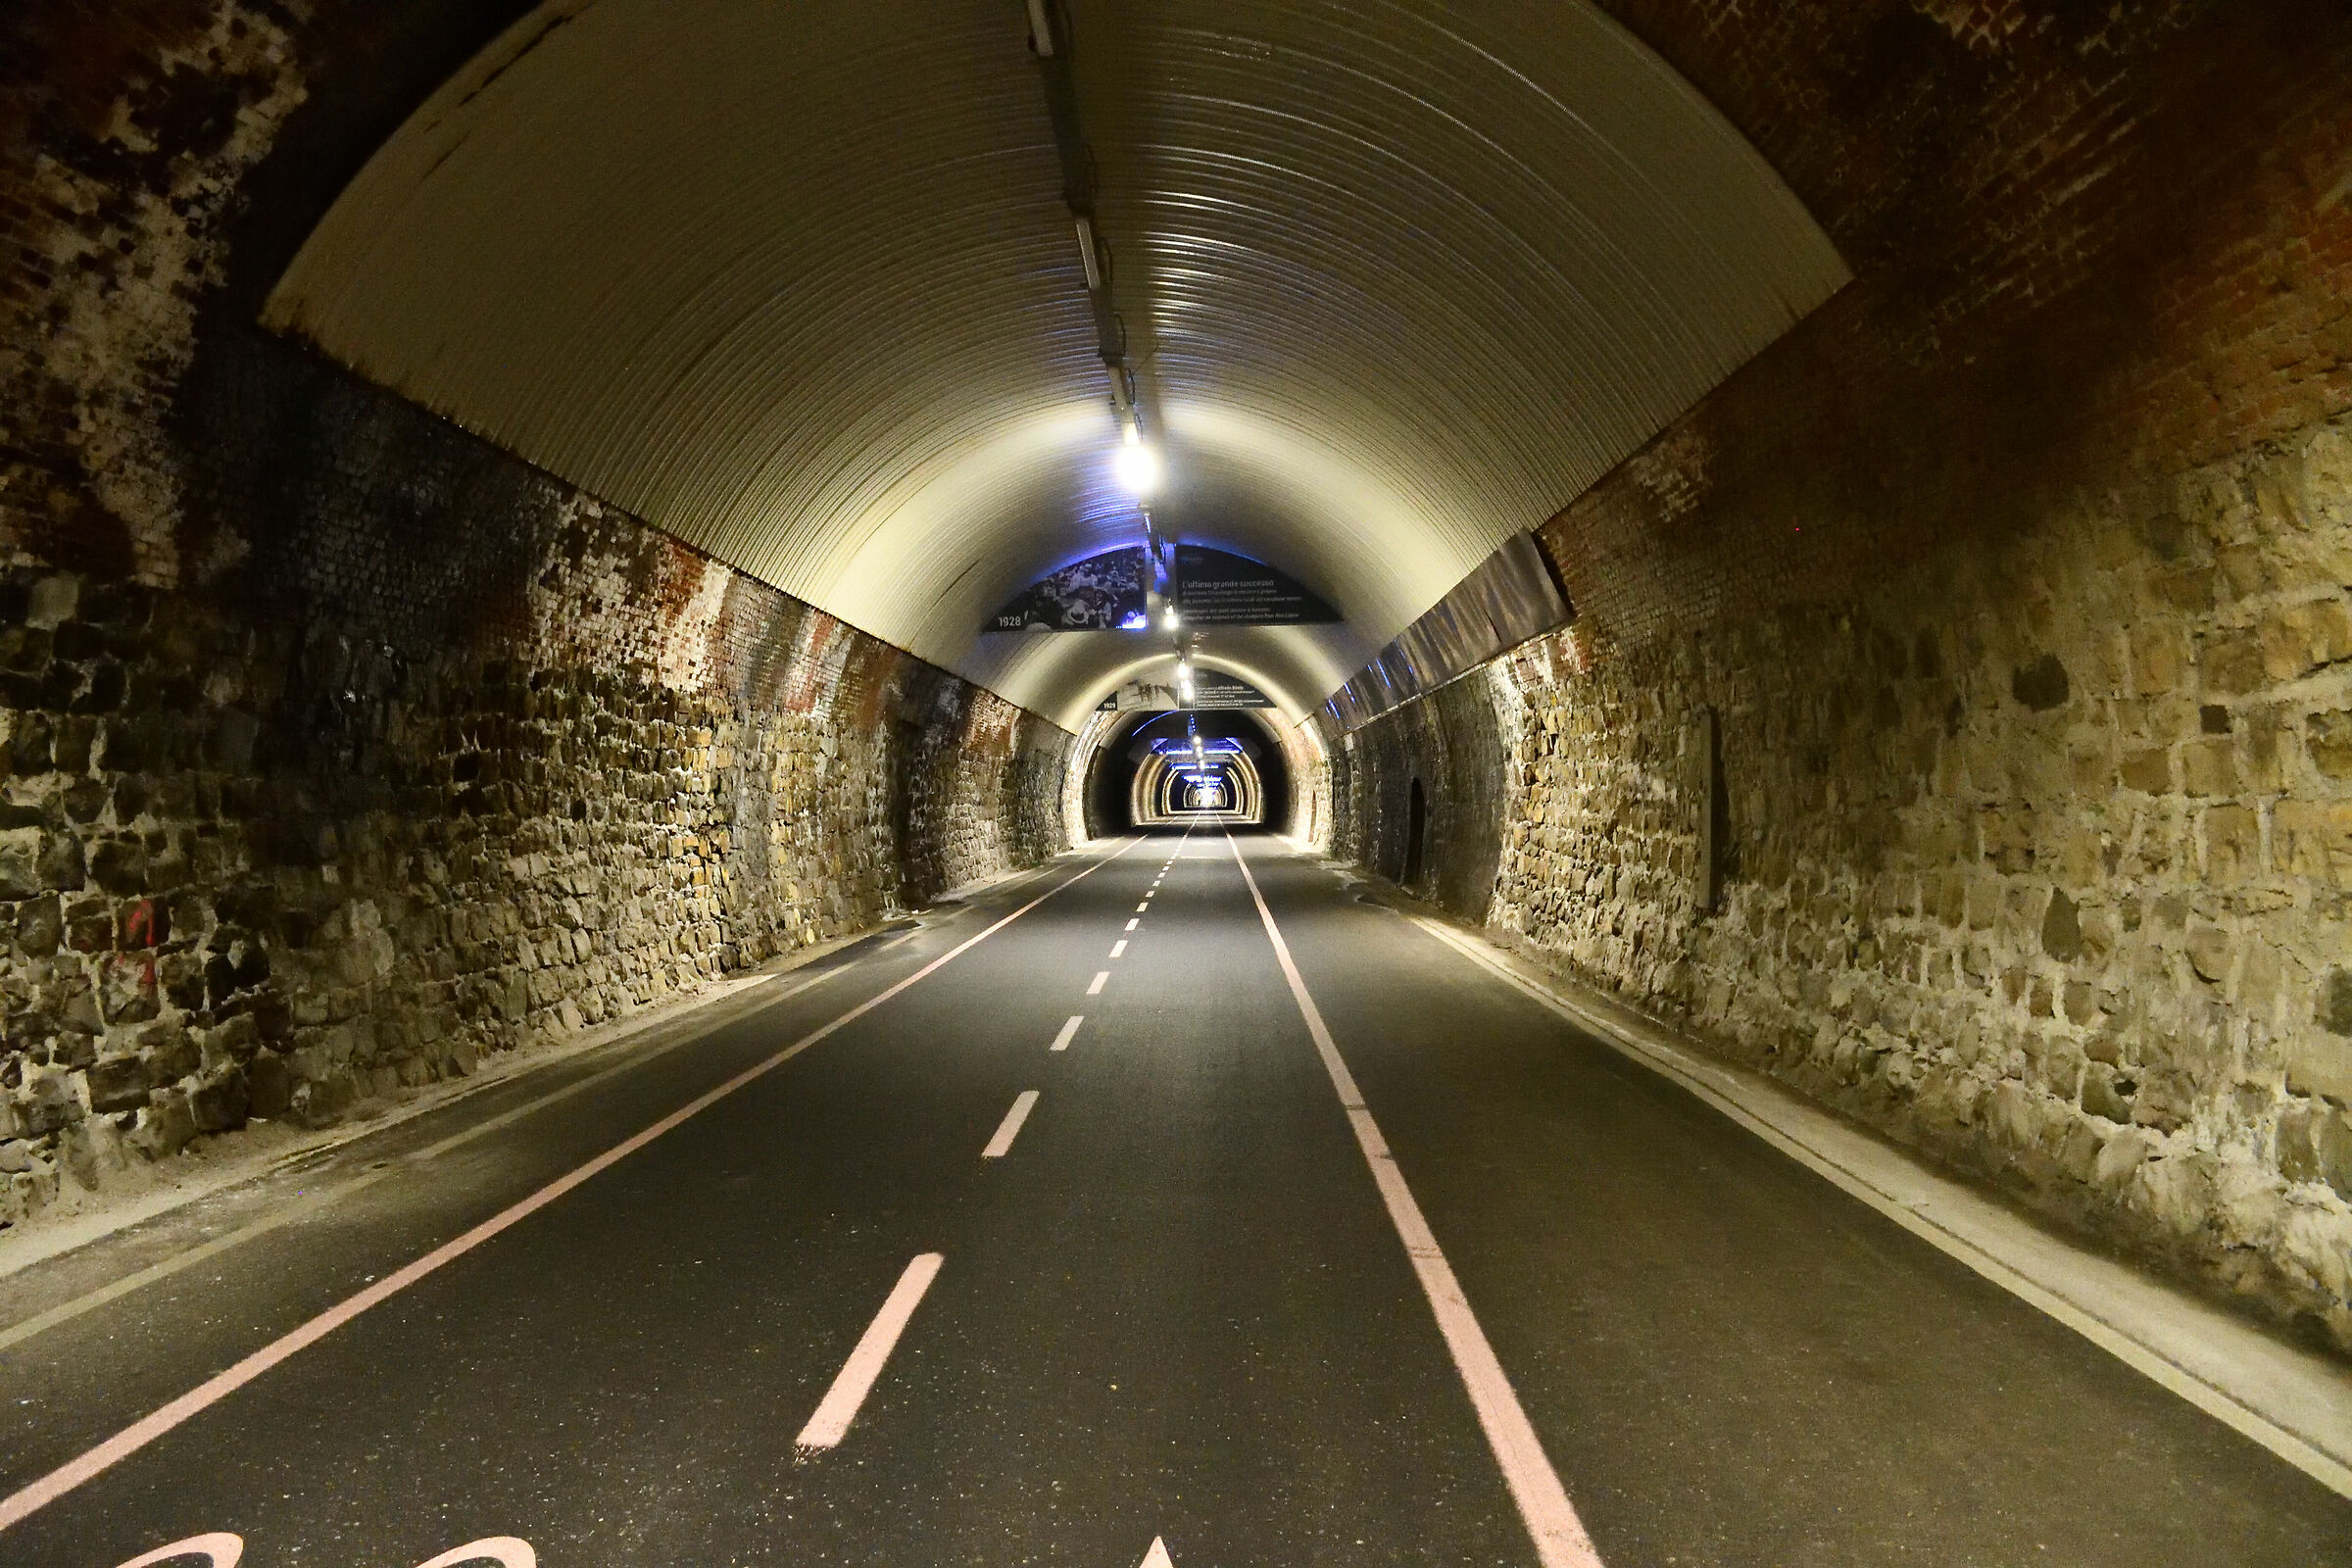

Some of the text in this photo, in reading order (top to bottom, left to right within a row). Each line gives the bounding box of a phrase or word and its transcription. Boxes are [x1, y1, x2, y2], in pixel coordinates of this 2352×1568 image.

[1182, 579, 1274, 590] L'ultimo grande successo
[998, 616, 1021, 627] 1928
